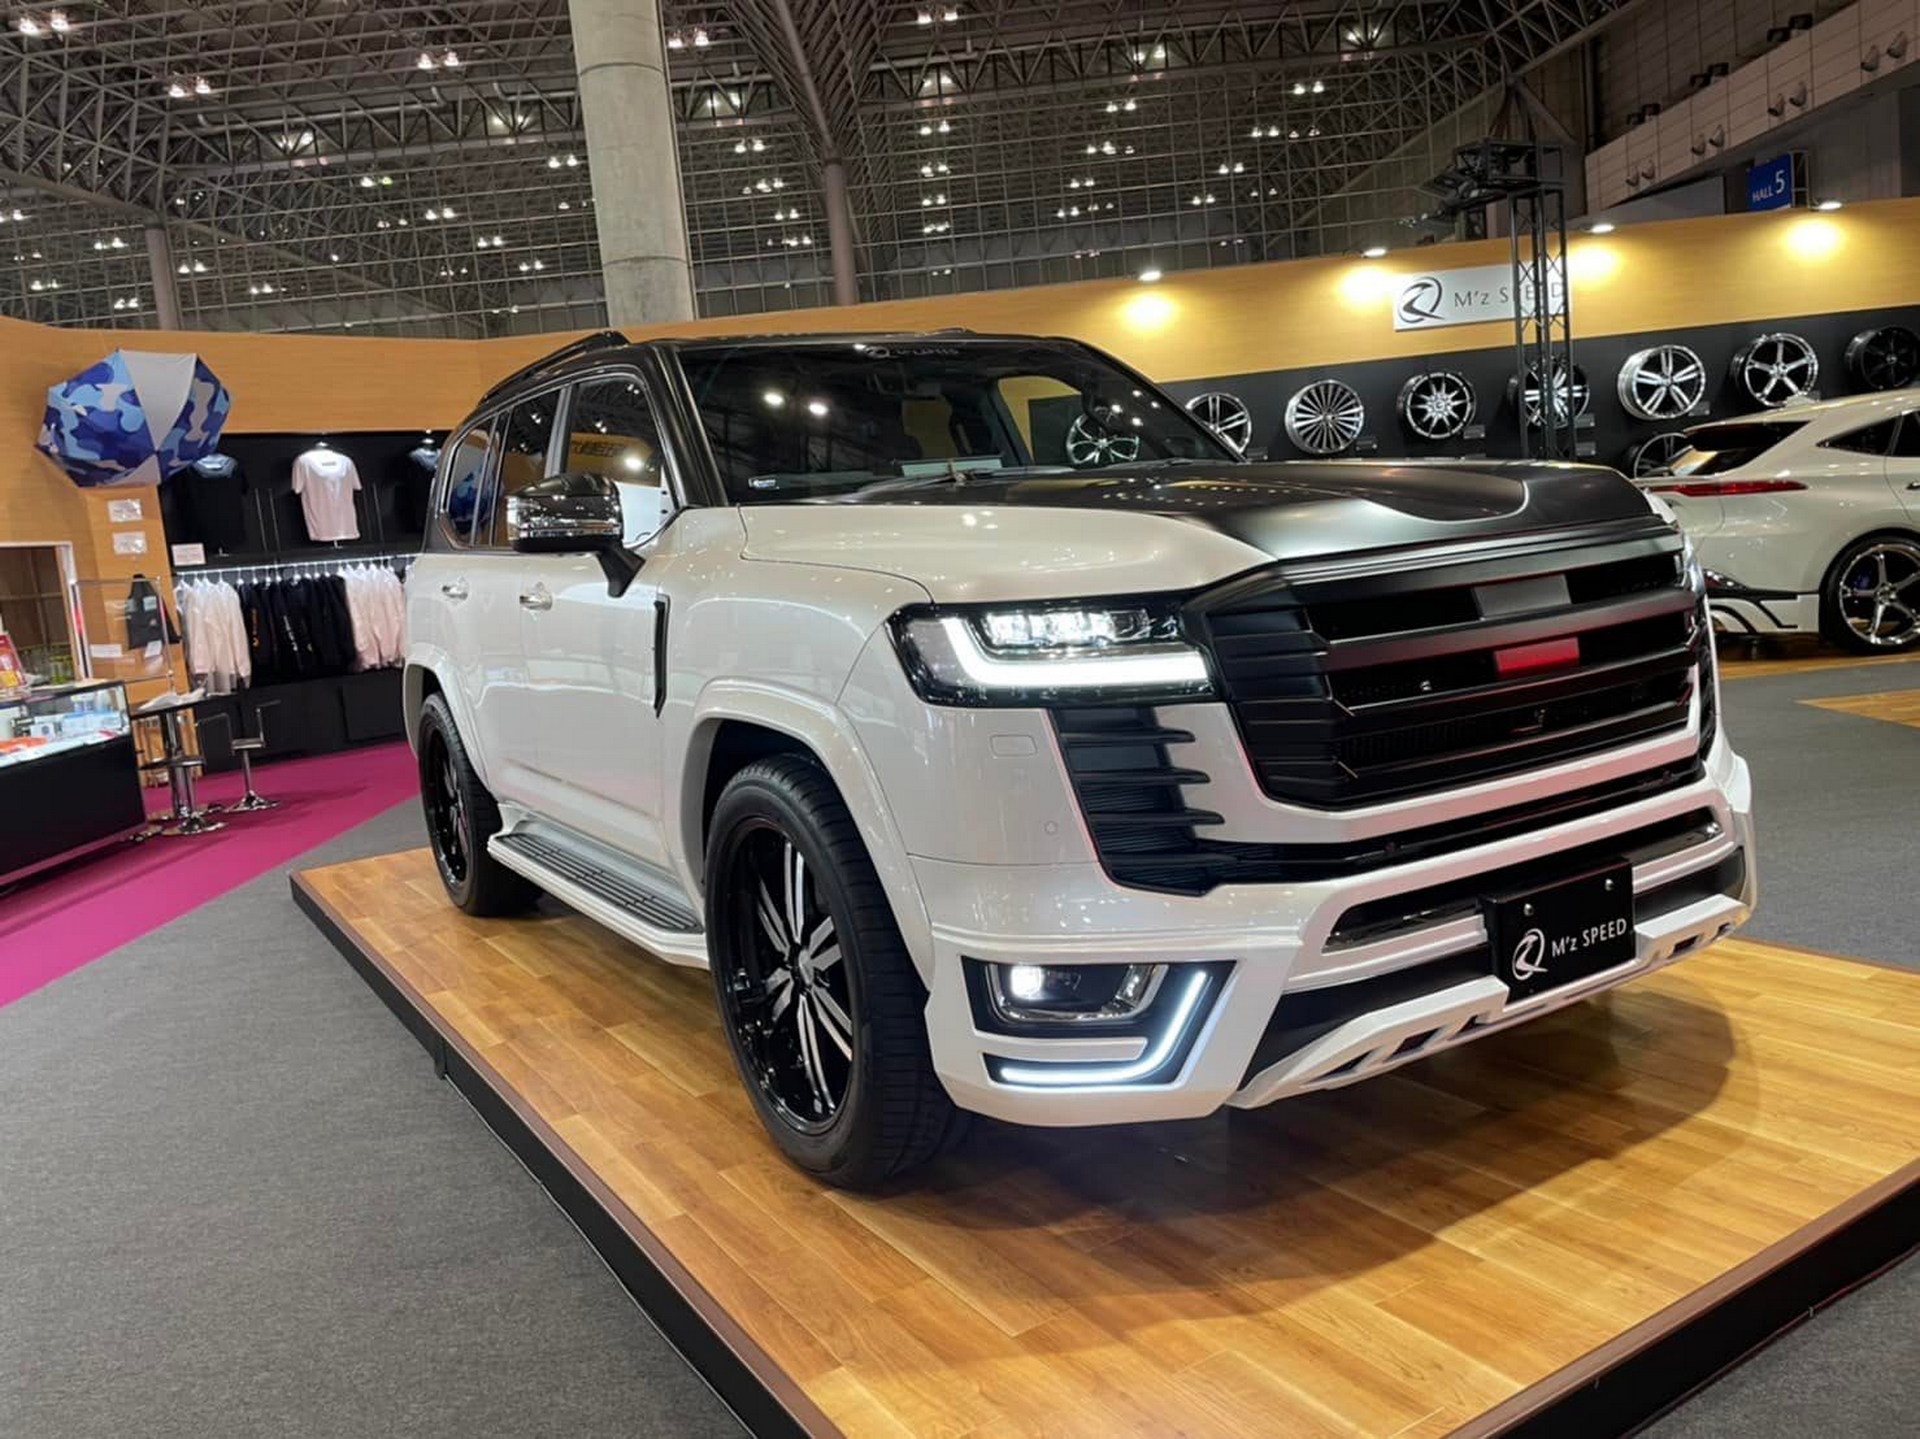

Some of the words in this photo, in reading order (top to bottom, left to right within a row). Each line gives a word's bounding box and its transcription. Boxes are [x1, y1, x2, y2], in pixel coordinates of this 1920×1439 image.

[1752, 185, 1774, 203] HALL
[1775, 169, 1786, 195] 5
[1454, 289, 1490, 308] M'z
[1499, 281, 1565, 305] SED
[1551, 935, 1578, 958] M'z
[1582, 918, 1627, 947] SPEED
